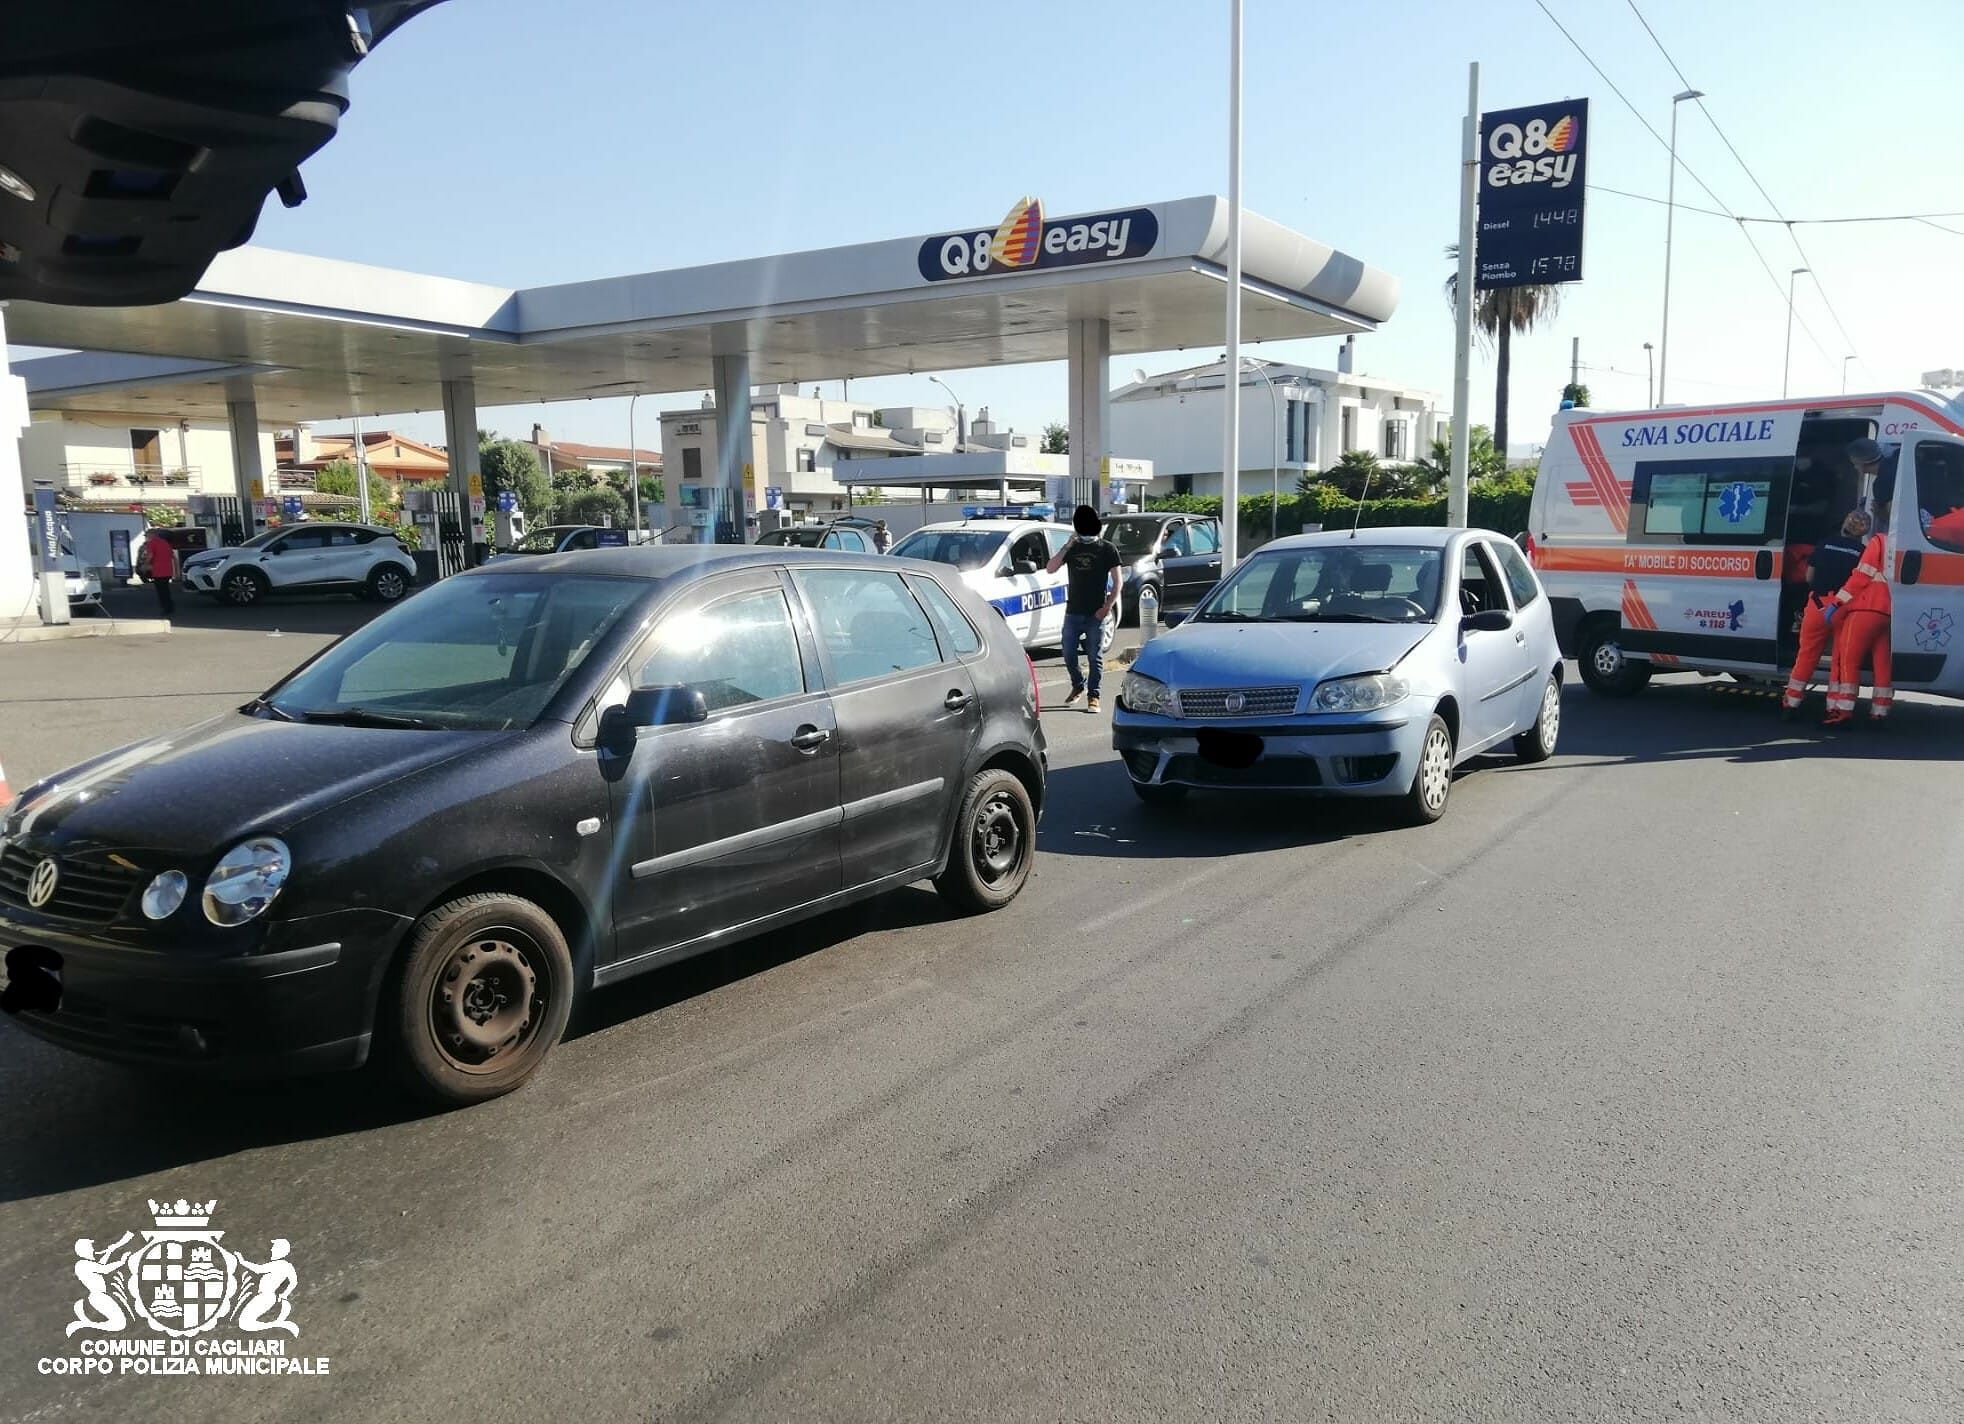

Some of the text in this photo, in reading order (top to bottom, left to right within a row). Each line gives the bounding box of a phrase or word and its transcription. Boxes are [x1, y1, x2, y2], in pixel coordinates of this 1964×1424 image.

[1489, 118, 1547, 159] Q8
[1488, 153, 1577, 188] easy
[1483, 220, 1510, 230] Diesel
[940, 219, 1131, 275] Q8 easy
[1482, 262, 1510, 271] Senza
[1482, 271, 1517, 280] Piombo
[1674, 418, 1775, 445] SOCIALE
[44, 510, 58, 558] Aria/Acqua
[1639, 555, 1676, 569] MOBILE
[1678, 556, 1689, 569] DI
[1690, 556, 1751, 571] SOCCORSO
[1021, 589, 1054, 612] POLIZIA
